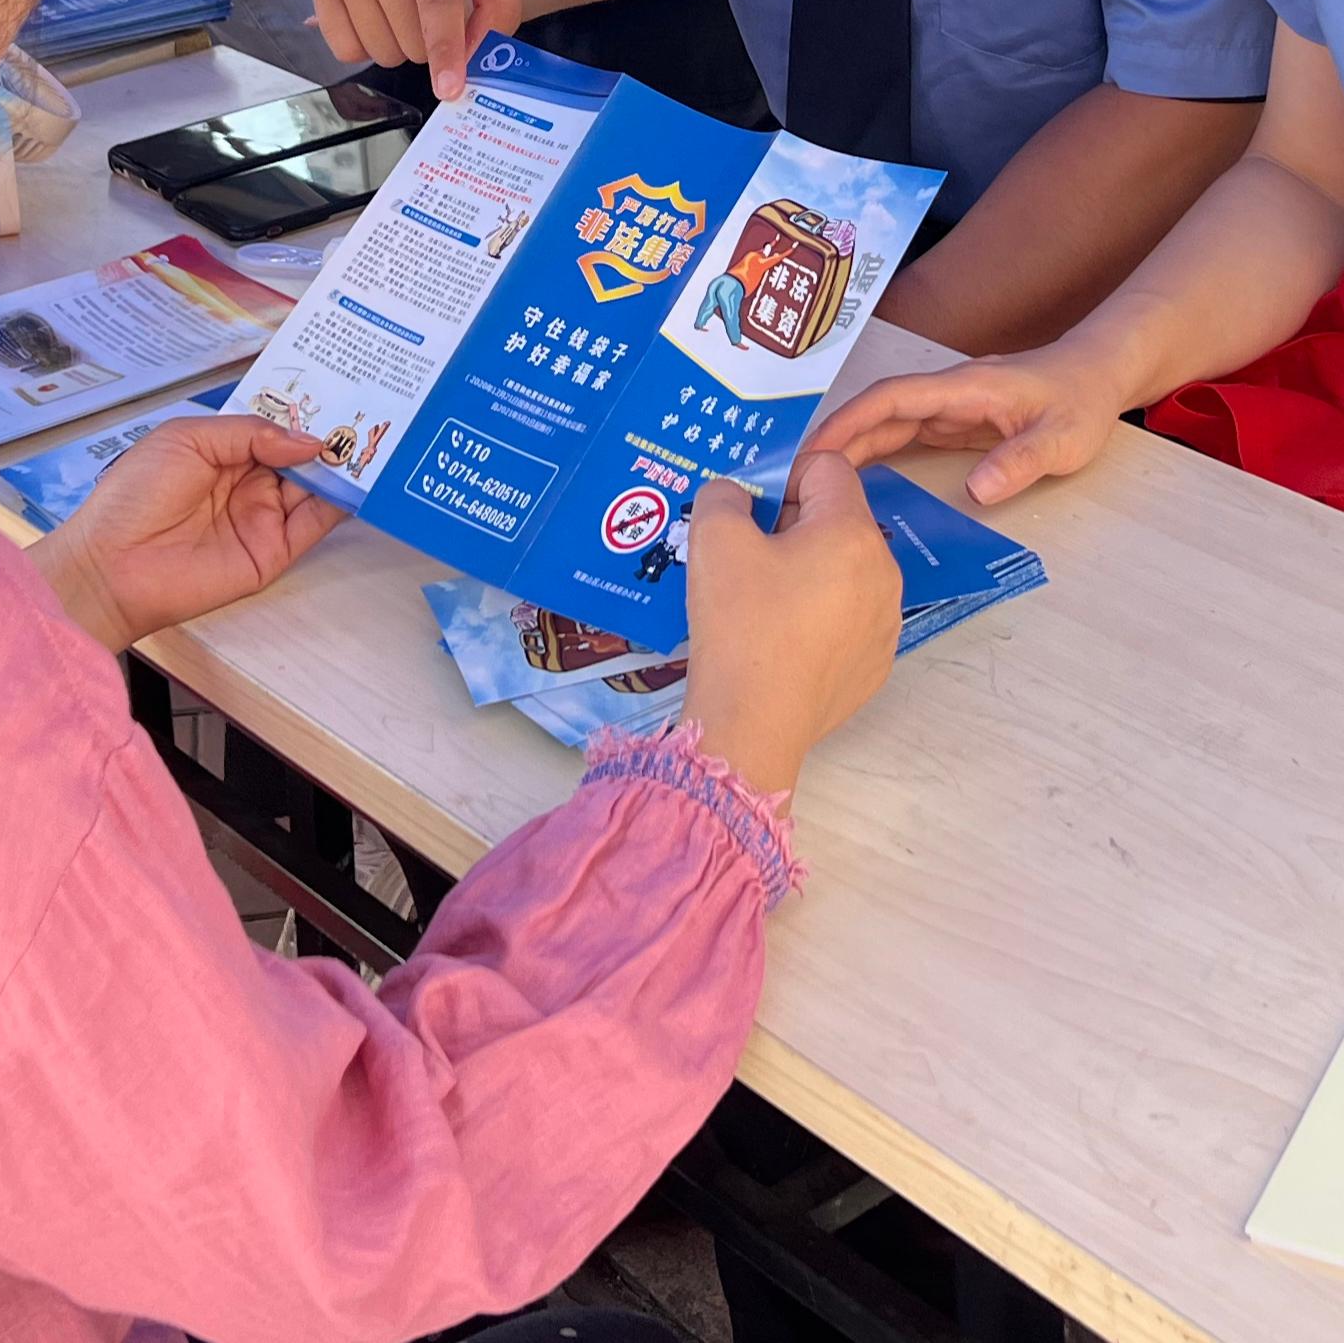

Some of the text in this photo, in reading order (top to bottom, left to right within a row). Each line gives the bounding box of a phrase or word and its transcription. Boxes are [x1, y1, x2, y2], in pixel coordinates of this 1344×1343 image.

[575, 207, 696, 275] 非法集资
[615, 196, 692, 240] 严厉打击
[768, 264, 809, 303] 非法
[523, 306, 629, 364] 守住钱袋子
[756, 294, 799, 338] 集资
[504, 331, 612, 391] 护好幸福家
[463, 439, 491, 463] 110
[433, 483, 517, 532] 0714-6480029
[447, 460, 532, 510] 0714-6205110
